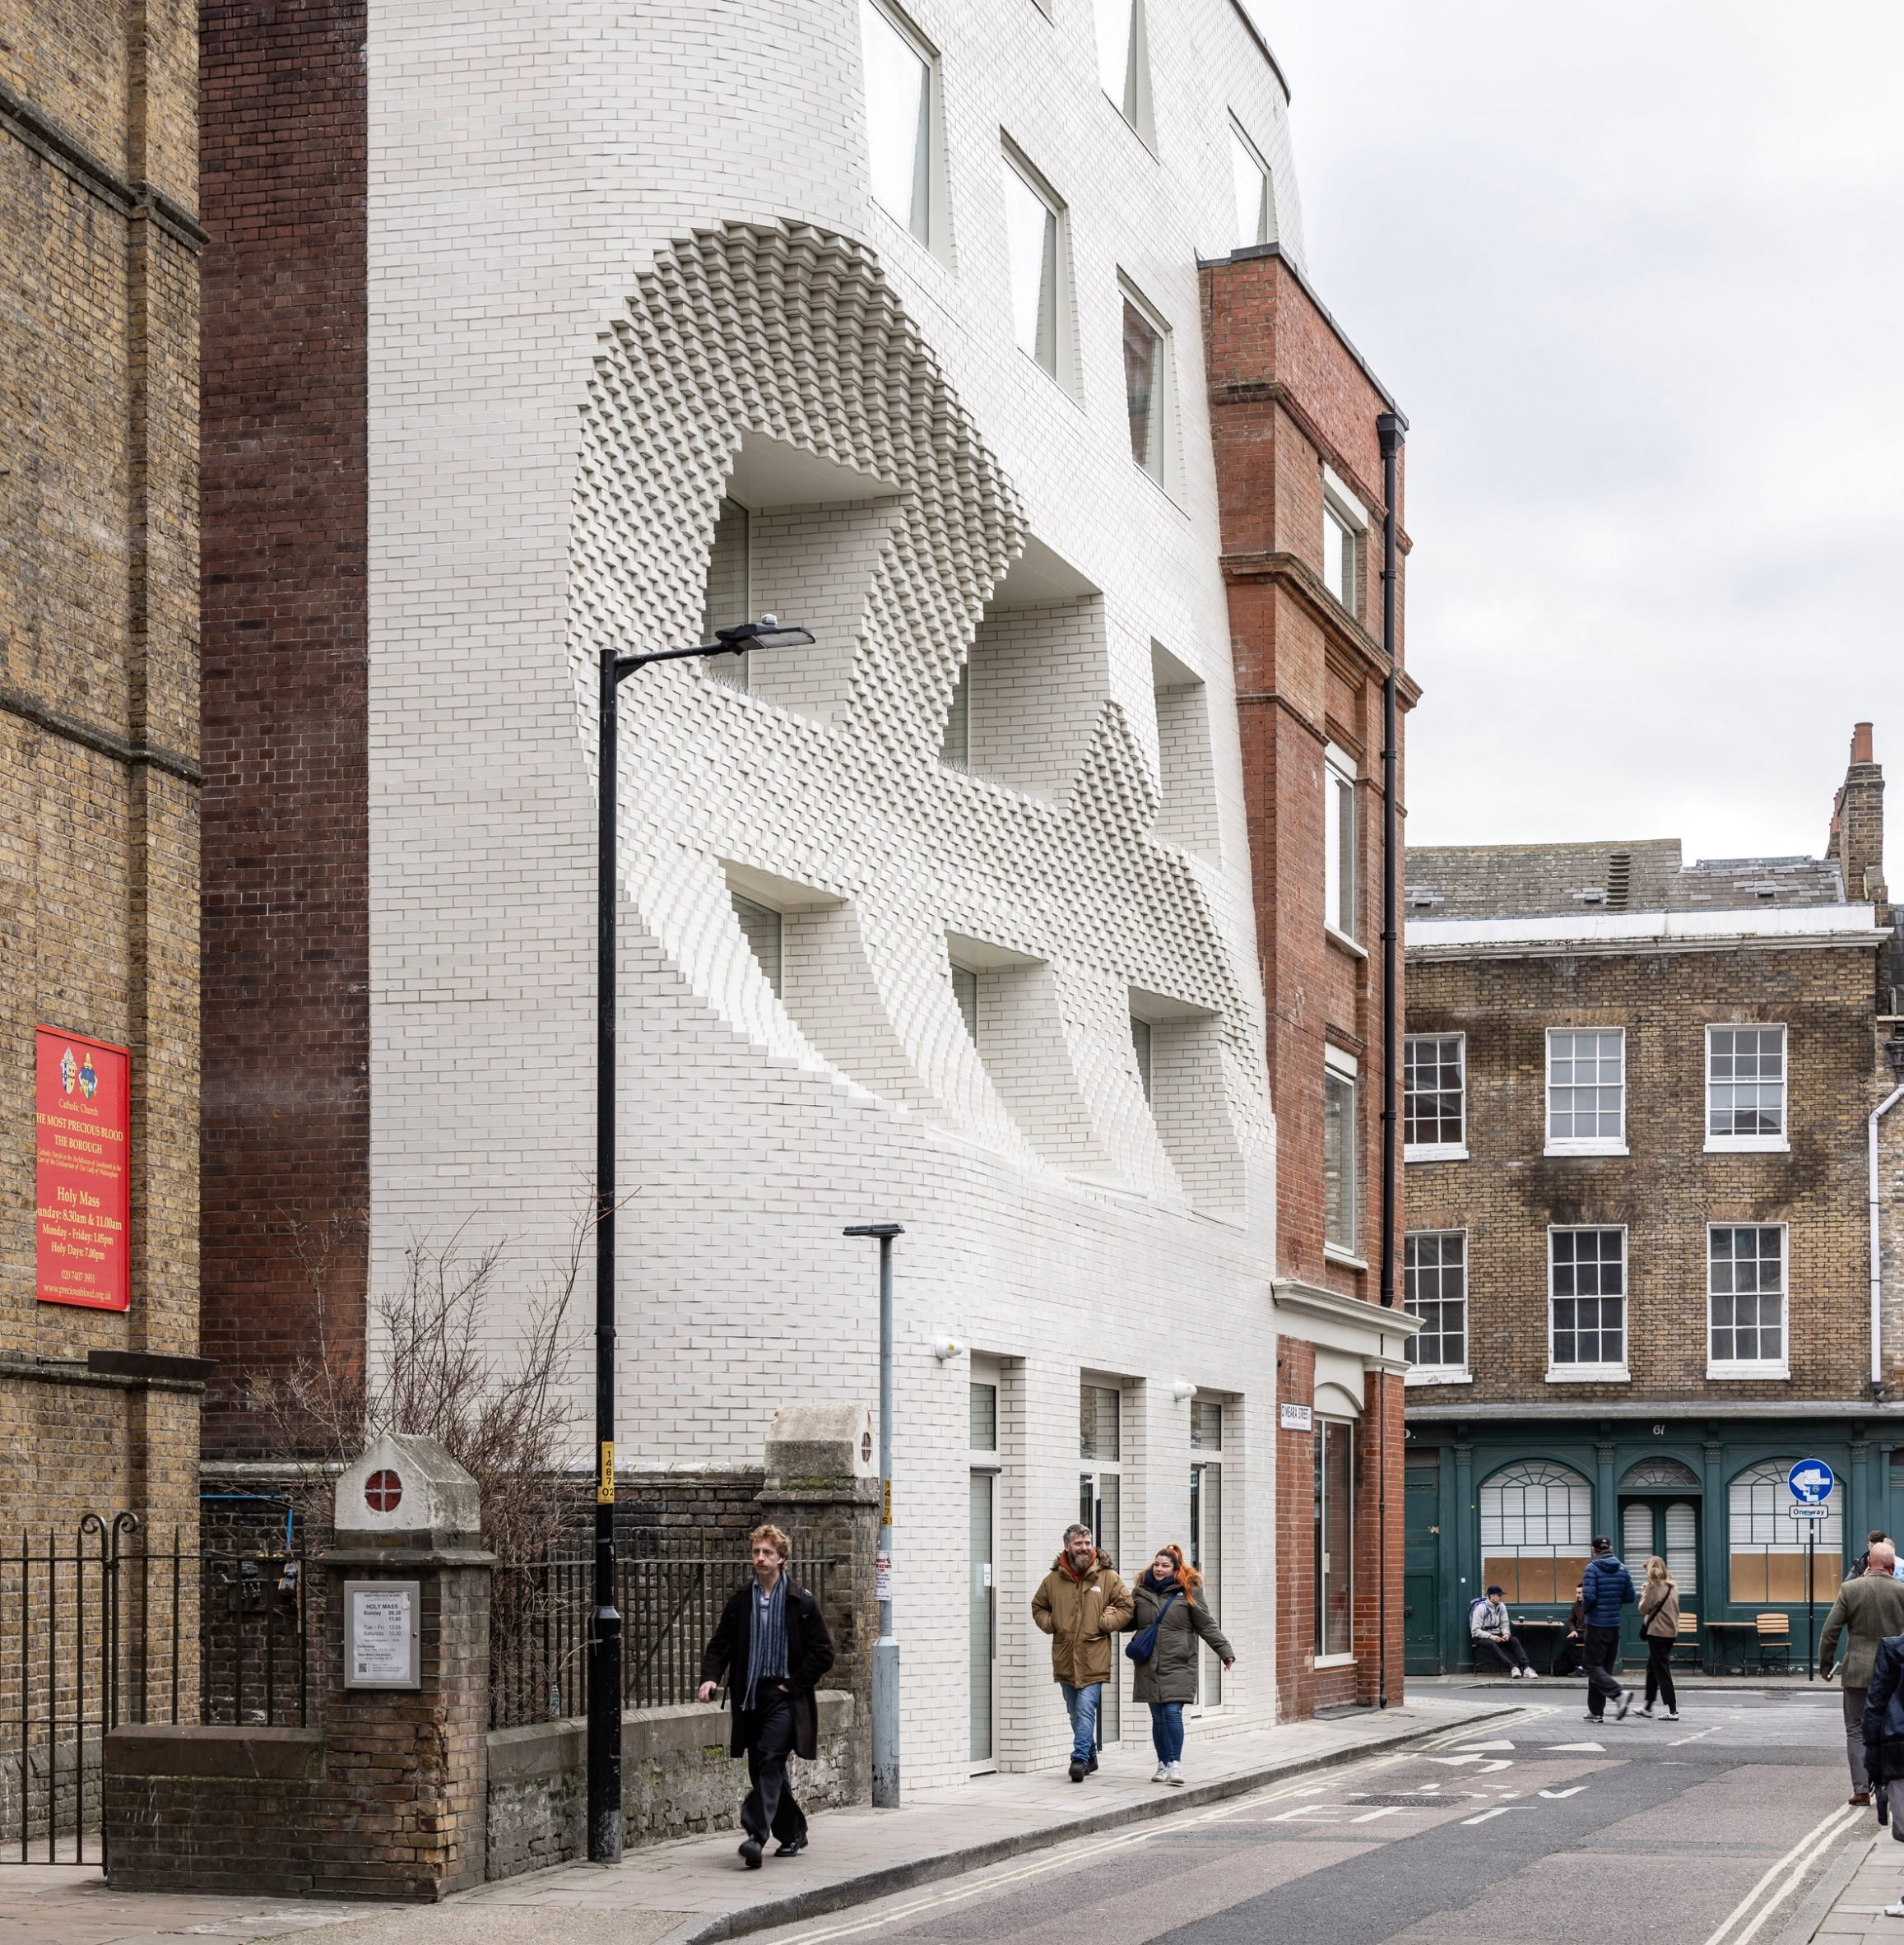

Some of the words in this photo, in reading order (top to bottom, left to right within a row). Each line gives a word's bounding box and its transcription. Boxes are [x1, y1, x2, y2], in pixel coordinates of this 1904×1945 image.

[58, 1098, 80, 1112] Catholic
[80, 1103, 98, 1116] Church
[36, 1112, 46, 1124] HE
[47, 1115, 67, 1129] MOST
[68, 1119, 100, 1136] PRECIOUS
[101, 1126, 123, 1141] BLOOD
[54, 1135, 68, 1147] THE
[69, 1138, 102, 1155] BOROUGH
[57, 1186, 77, 1207] Holy
[79, 1191, 100, 1208] Mass
[36, 1205, 62, 1223] unday:
[63, 1209, 86, 1224] 8.30am
[88, 1214, 95, 1226] &
[96, 1215, 122, 1230] 11.00am
[42, 1223, 67, 1240] Monday
[72, 1228, 93, 1244] Friday:
[93, 1232, 114, 1247] 1.05pm
[51, 1242, 67, 1256] Holy
[67, 1244, 85, 1259] Days:
[85, 1247, 105, 1262] 7.00pm
[61, 1270, 71, 1280] 020
[71, 1271, 83, 1282] 7407
[84, 1273, 95, 1284] 3951
[44, 1284, 112, 1302] www.preciousblood.org.uk
[1653, 1424, 1665, 1435] 61
